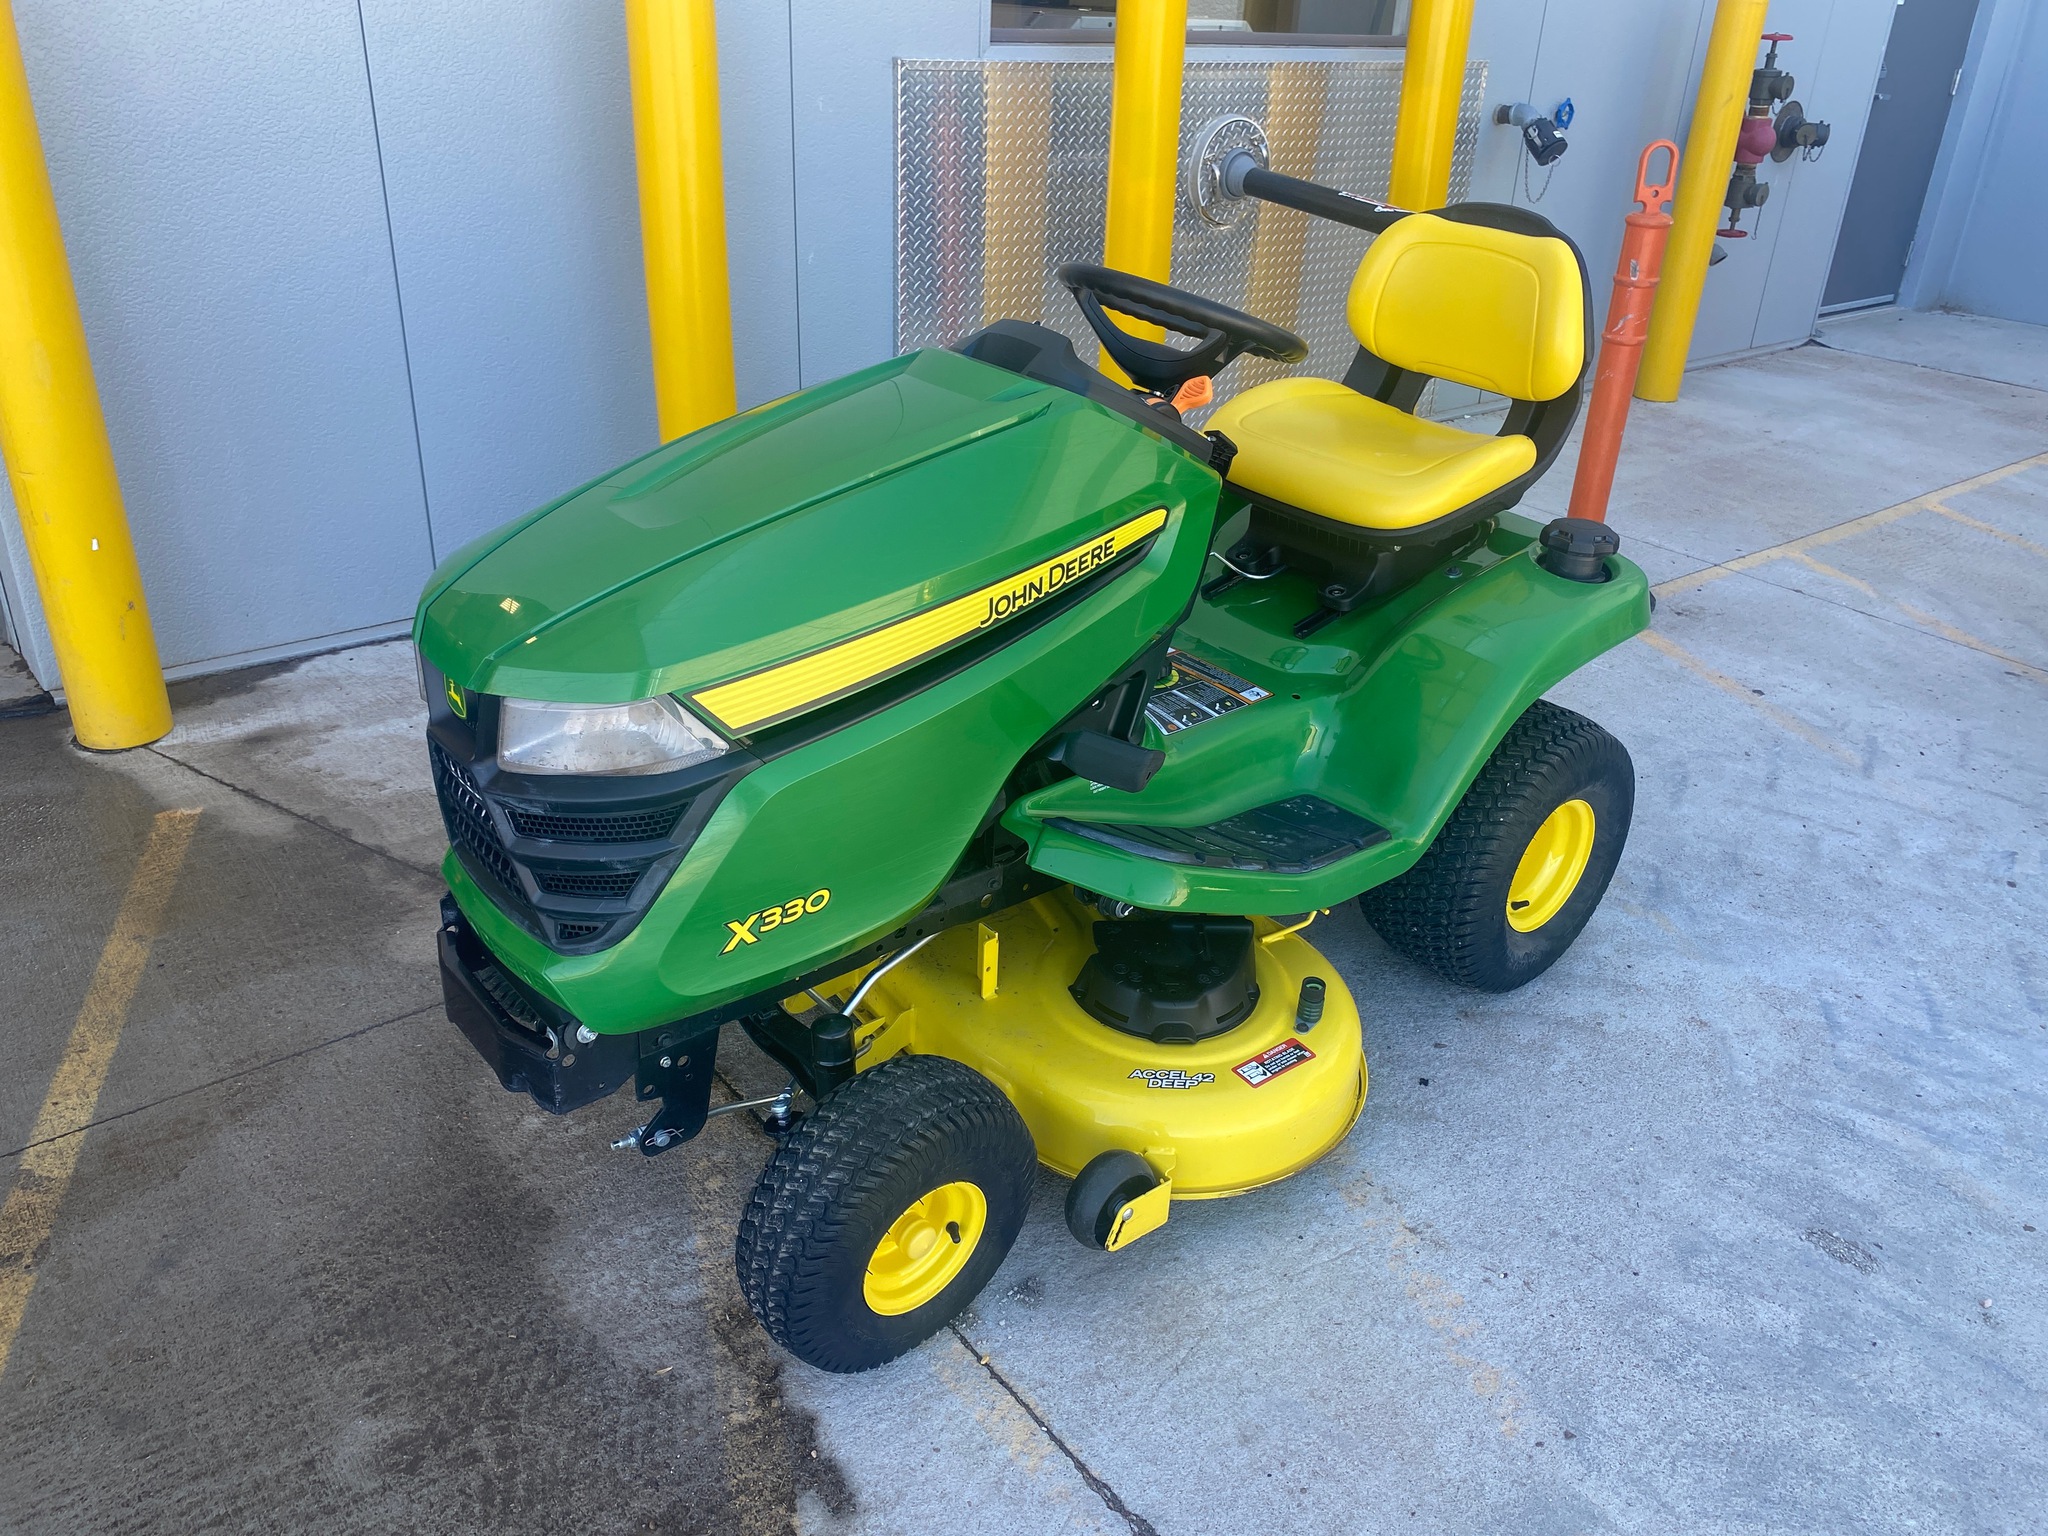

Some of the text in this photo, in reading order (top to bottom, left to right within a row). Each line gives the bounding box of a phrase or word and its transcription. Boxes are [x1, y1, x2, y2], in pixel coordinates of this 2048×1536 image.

[980, 536, 1116, 628] JOHN DEERE
[719, 888, 831, 957] X330
[1267, 1044, 1288, 1056] DANGER
[1129, 1069, 1215, 1083] ACCEL 42
[1148, 1079, 1199, 1089] DEEP
